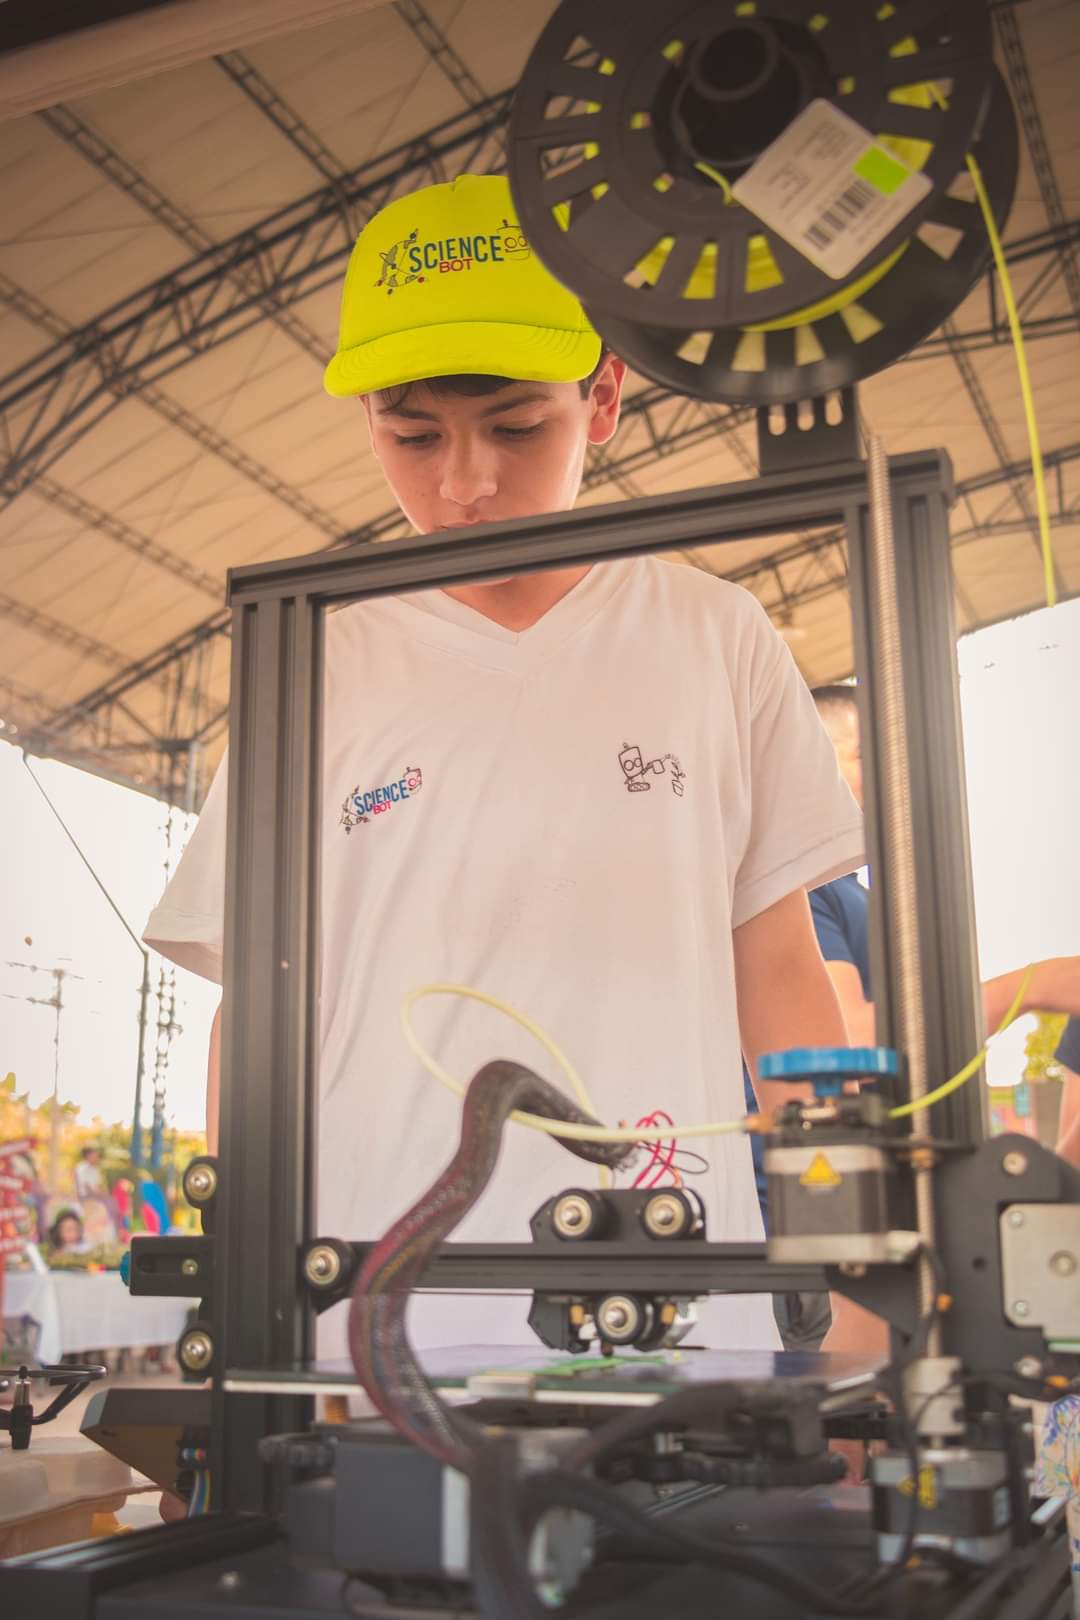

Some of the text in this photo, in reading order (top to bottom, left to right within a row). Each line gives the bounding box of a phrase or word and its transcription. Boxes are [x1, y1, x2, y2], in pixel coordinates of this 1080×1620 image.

[409, 235, 504, 273] SCIENCE
[439, 258, 473, 273] BOT
[353, 779, 410, 815] SCIENCE
[373, 800, 391, 815] BOT
